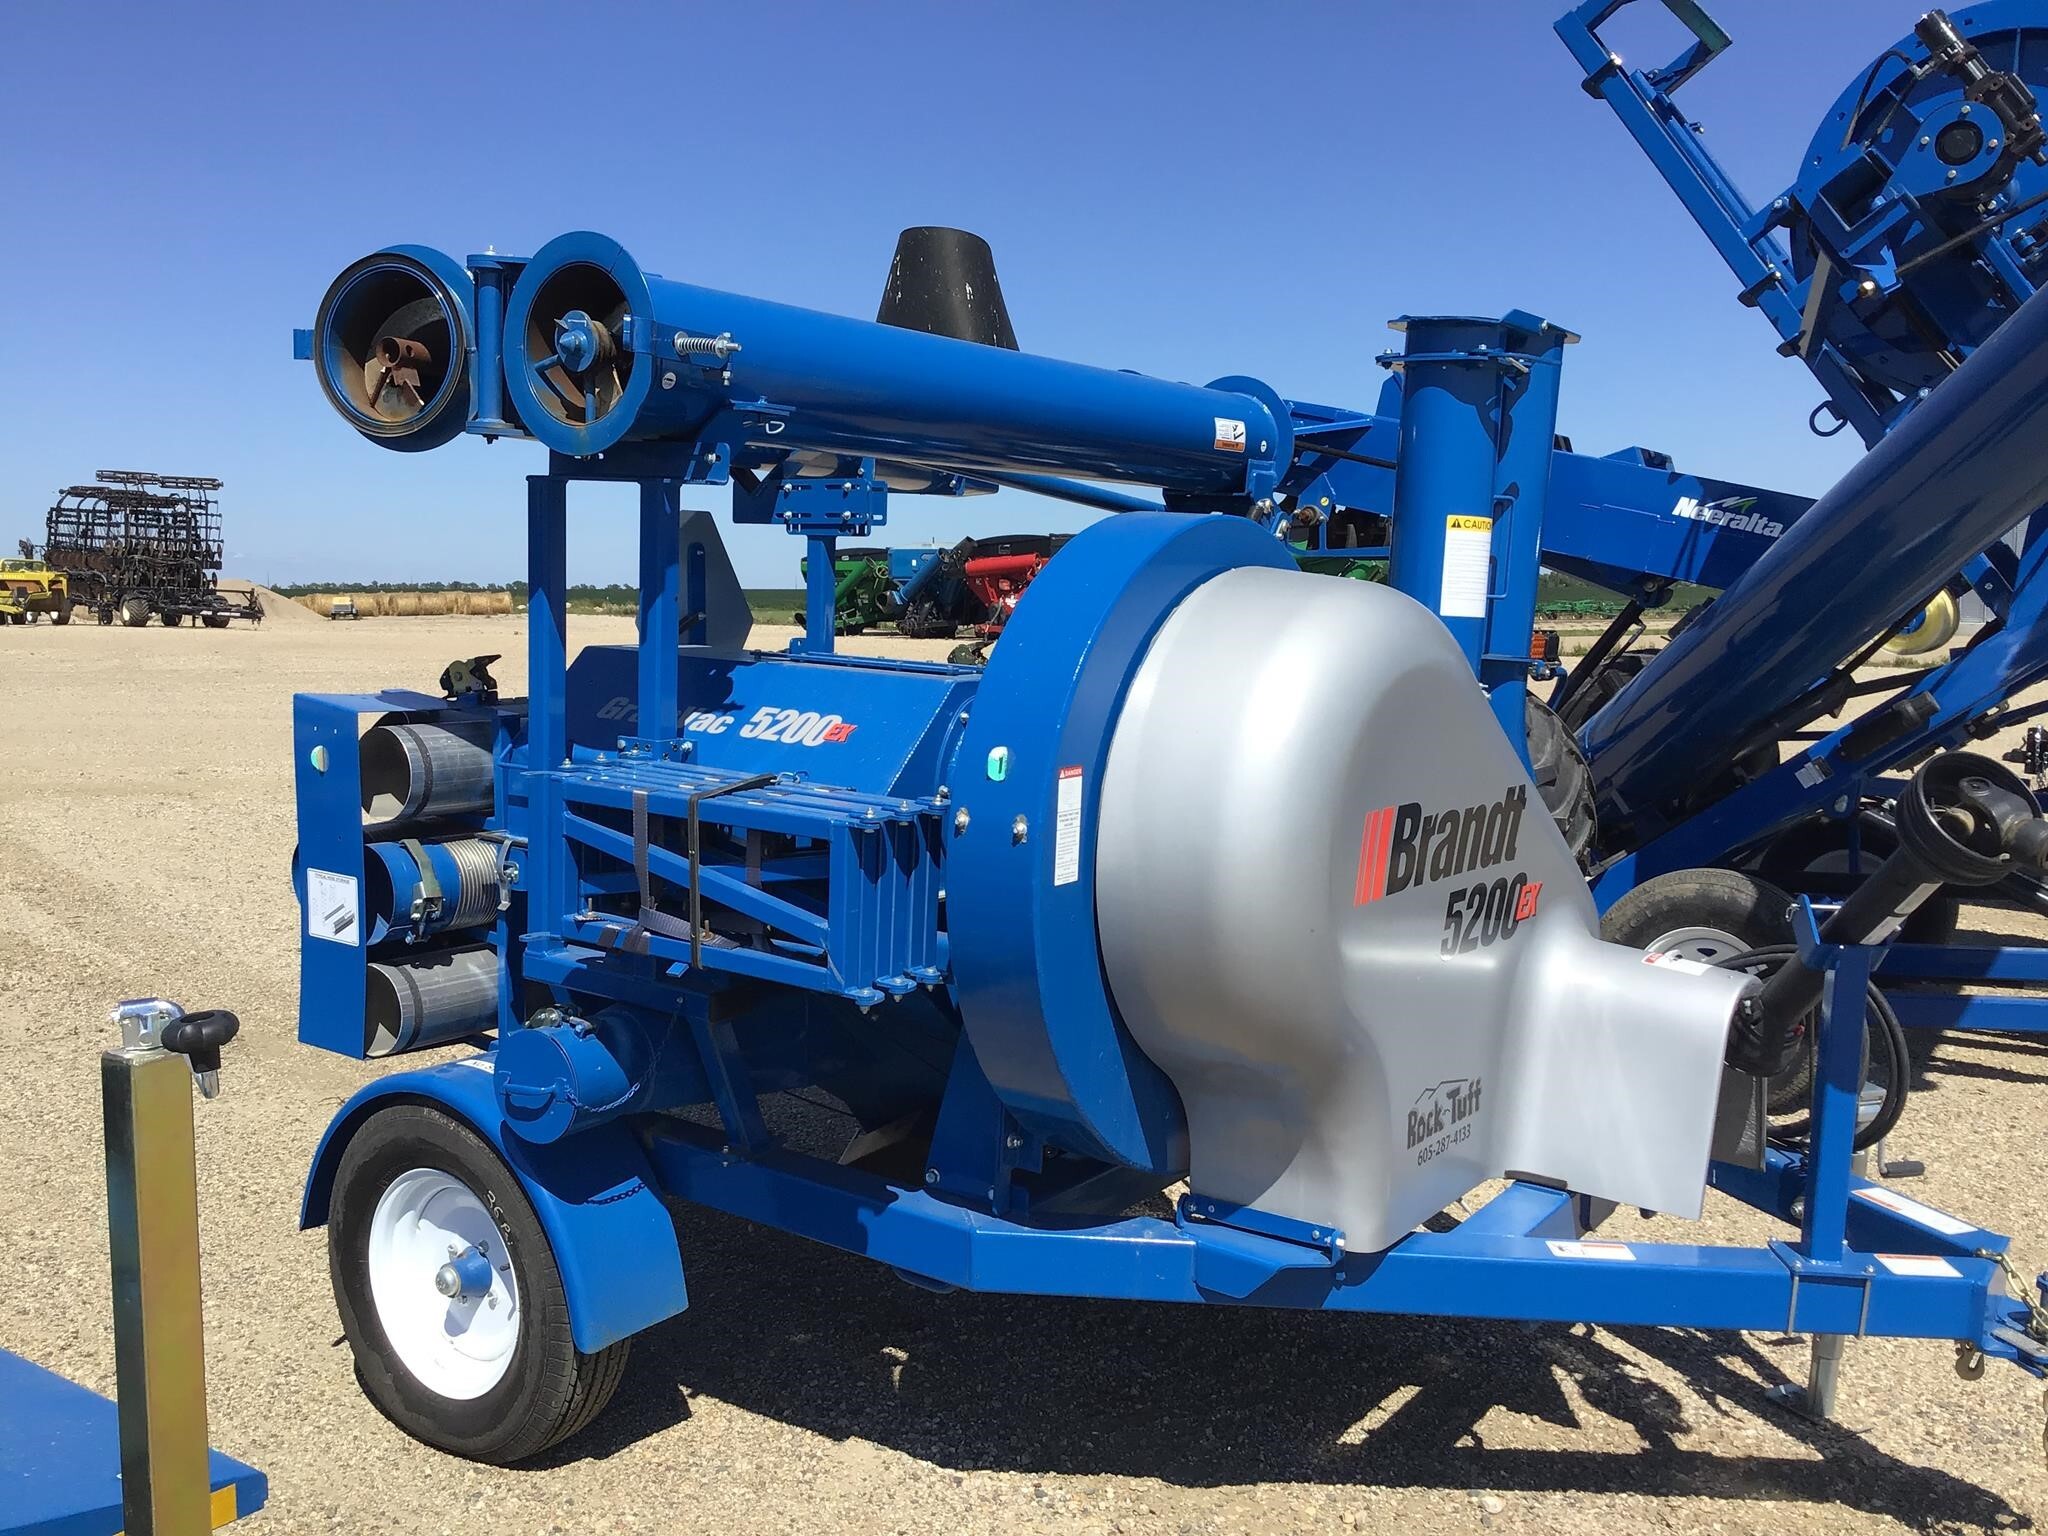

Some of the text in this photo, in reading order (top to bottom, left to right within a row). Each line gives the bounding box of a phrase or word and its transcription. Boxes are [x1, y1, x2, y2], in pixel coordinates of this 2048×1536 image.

[1672, 496, 1783, 538] Neeralta
[1385, 783, 1528, 897] Brandt
[1417, 1122, 1472, 1167] 605-287-4133
